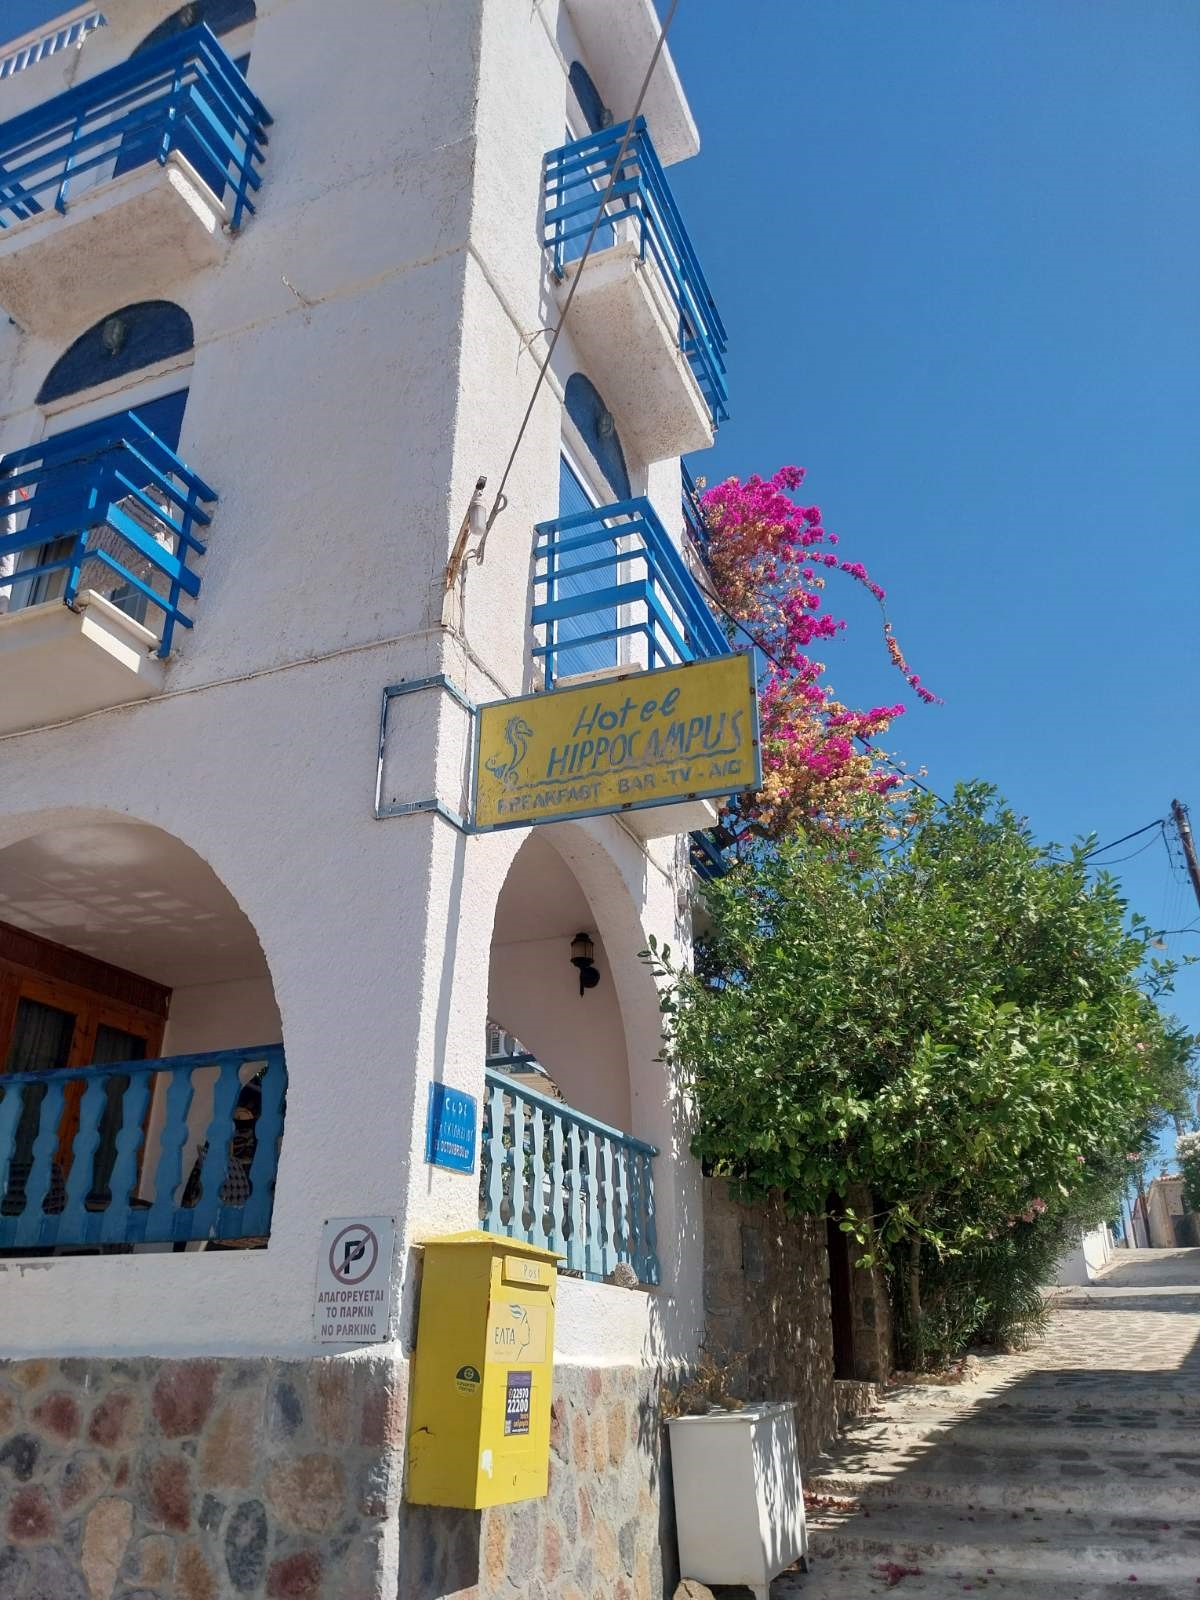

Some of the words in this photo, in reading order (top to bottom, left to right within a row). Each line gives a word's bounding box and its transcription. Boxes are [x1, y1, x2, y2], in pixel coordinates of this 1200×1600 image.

[573, 687, 681, 737] Hotel
[547, 709, 744, 778] HIPPOCAMPUS
[618, 773, 657, 795] BAR
[318, 1289, 384, 1303] ΑΠΑΓΟΡΕΥΕΤΑΙ
[326, 1306, 338, 1318] ΤΟ
[340, 1305, 374, 1318] ΠΑΡΚΙΝ
[321, 1324, 334, 1336] NO
[336, 1323, 376, 1336] PARKING
[494, 1326, 516, 1345] ΕΛΤΑ
[507, 1399, 529, 1413] 22200
